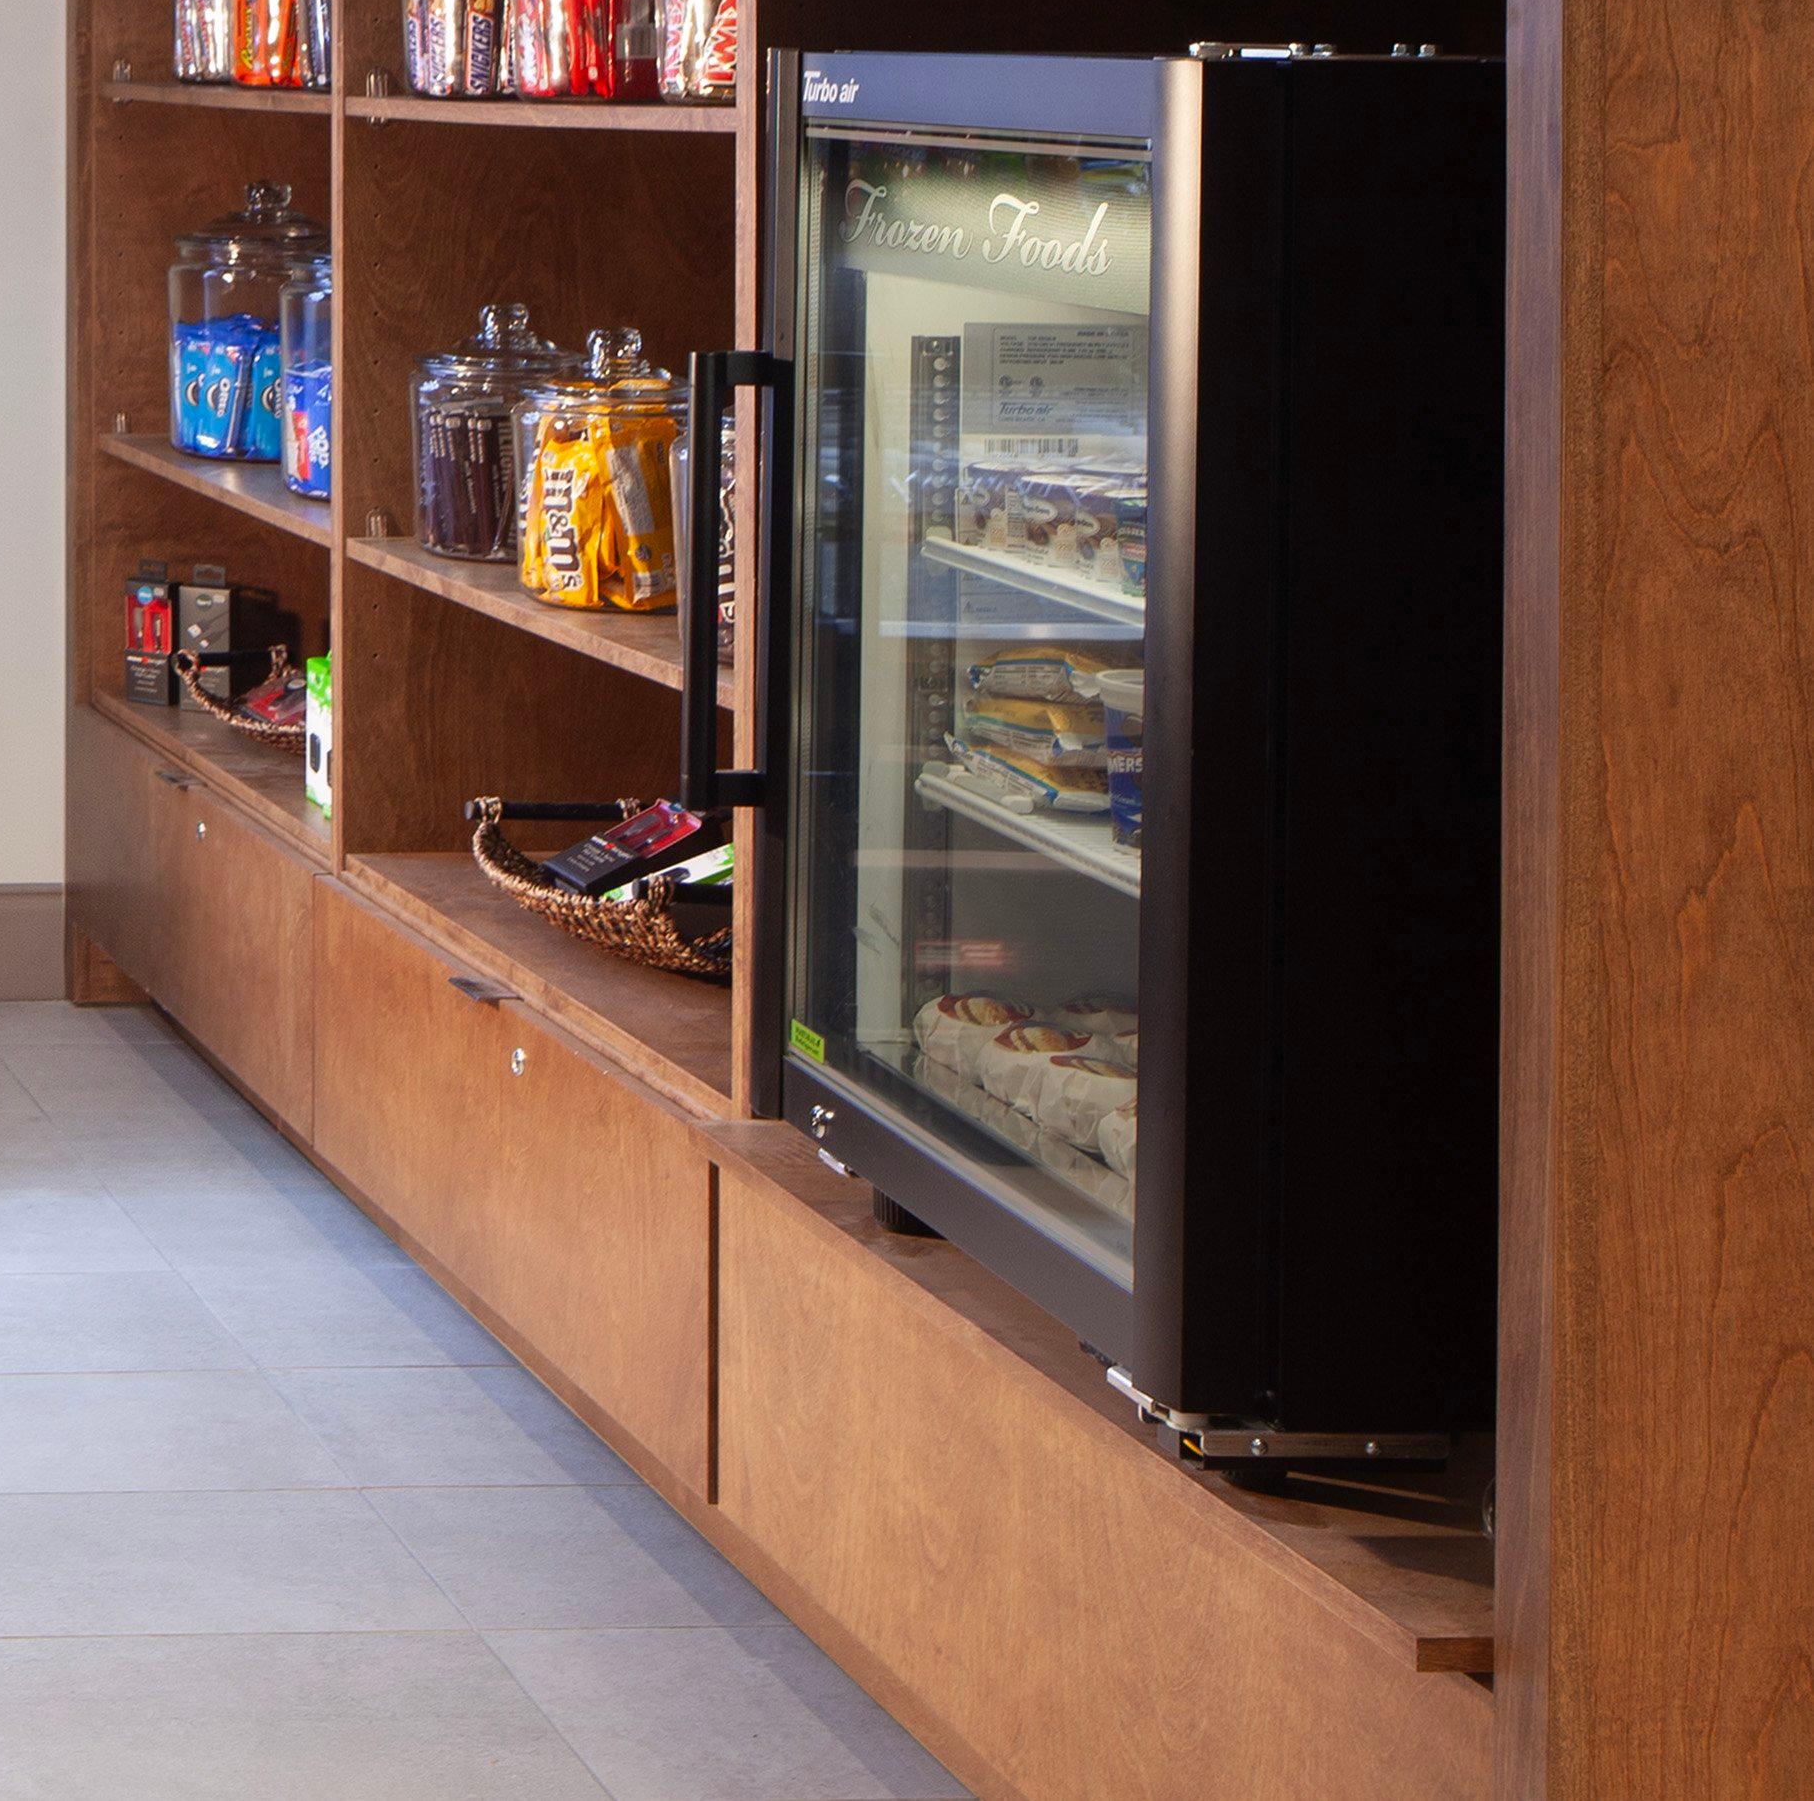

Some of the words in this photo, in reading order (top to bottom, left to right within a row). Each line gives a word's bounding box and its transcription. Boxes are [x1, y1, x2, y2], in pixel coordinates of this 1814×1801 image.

[469, 14, 493, 95] SNICKERS
[803, 70, 838, 103] Turbo
[840, 77, 859, 103] air
[839, 177, 971, 260] Frozen
[982, 192, 1113, 277] Foods
[999, 402, 1034, 416] Turbo
